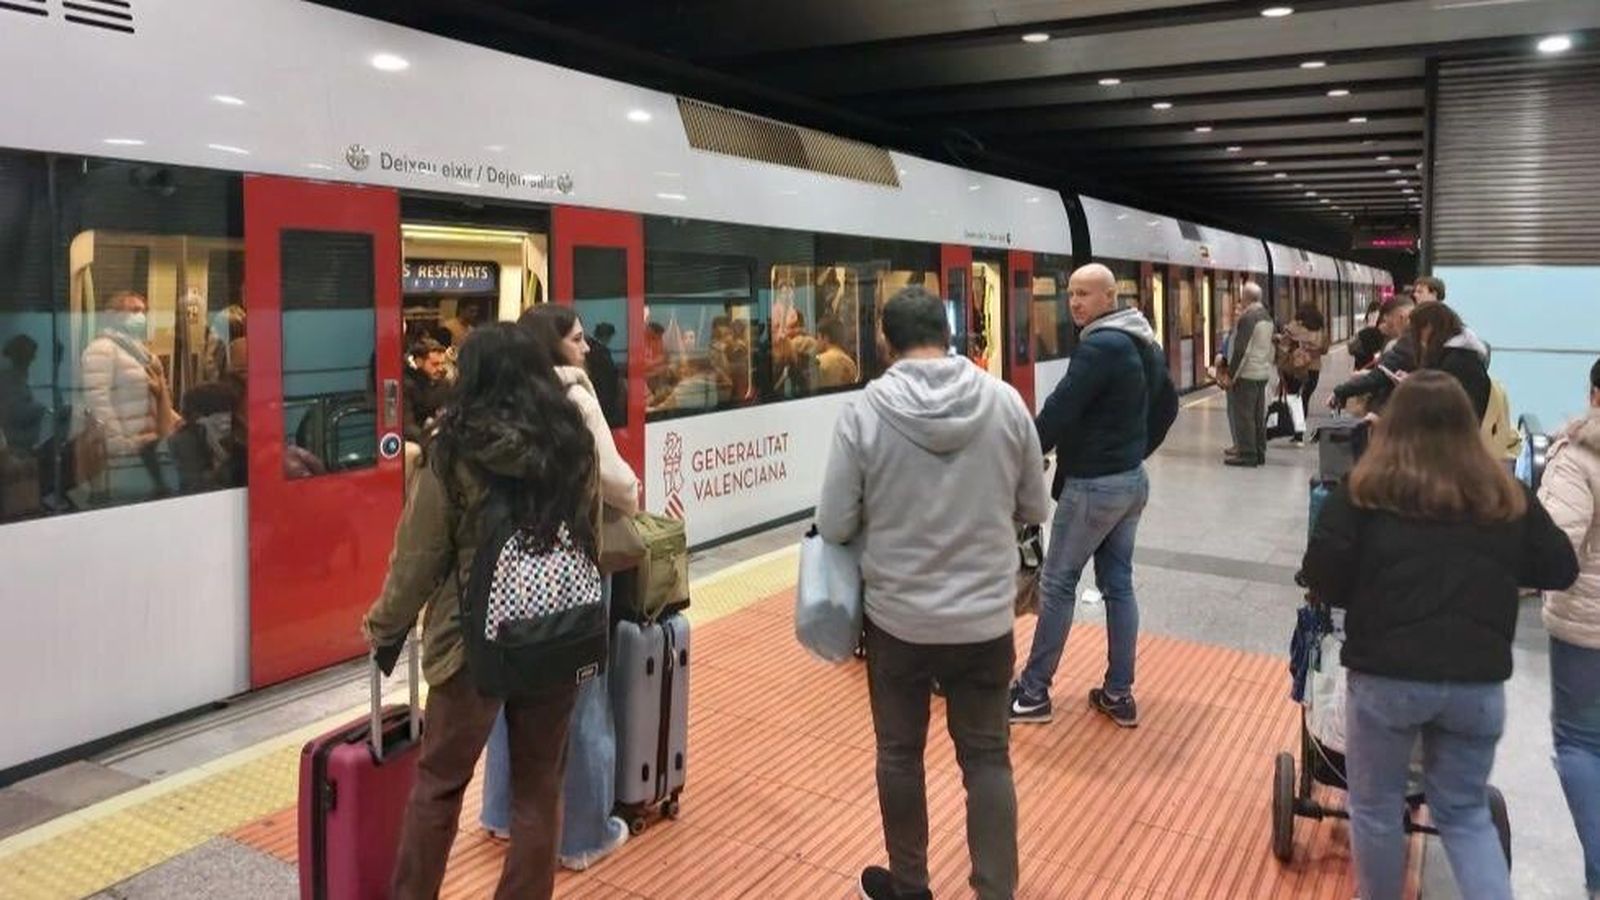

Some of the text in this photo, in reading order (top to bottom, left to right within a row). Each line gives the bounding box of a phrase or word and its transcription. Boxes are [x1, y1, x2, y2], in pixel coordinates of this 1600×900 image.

[380, 152, 437, 173] Deixeu
[441, 162, 473, 181] eixir
[476, 165, 482, 182] /
[487, 166, 526, 189] Dejen
[418, 264, 488, 279] RESERVATS
[691, 432, 788, 473] GENERALITAT
[694, 461, 787, 501] VALENCIANA
